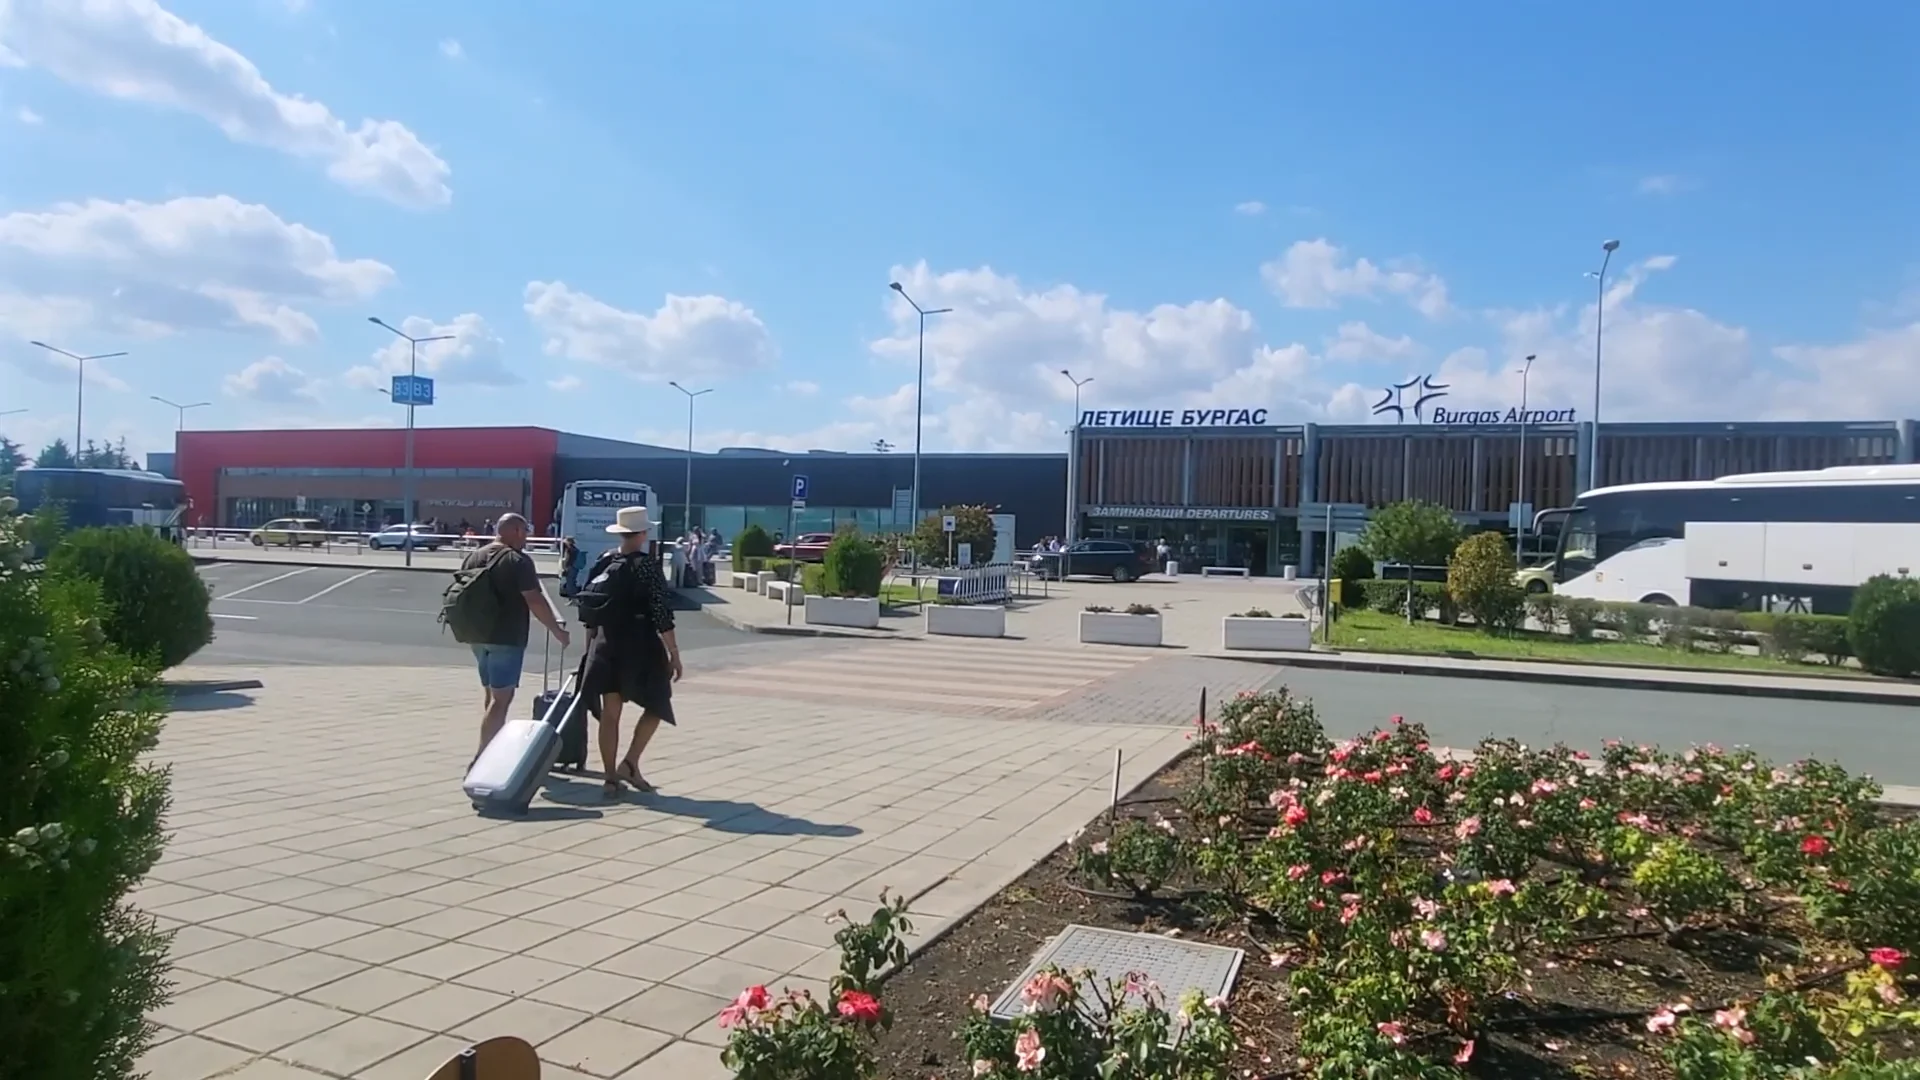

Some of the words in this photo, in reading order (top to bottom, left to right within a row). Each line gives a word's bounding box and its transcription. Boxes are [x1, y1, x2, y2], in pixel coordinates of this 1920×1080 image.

[1079, 410, 1174, 427] ЛЕТИЩЕ
[1181, 409, 1268, 425] БУРГАС
[1433, 407, 1501, 425] Burgas
[1503, 407, 1576, 424] Airport
[796, 478, 804, 495] P
[1092, 507, 1183, 519] ЗАМИНАВАЩИ
[1186, 509, 1269, 520] DEPARTURES
